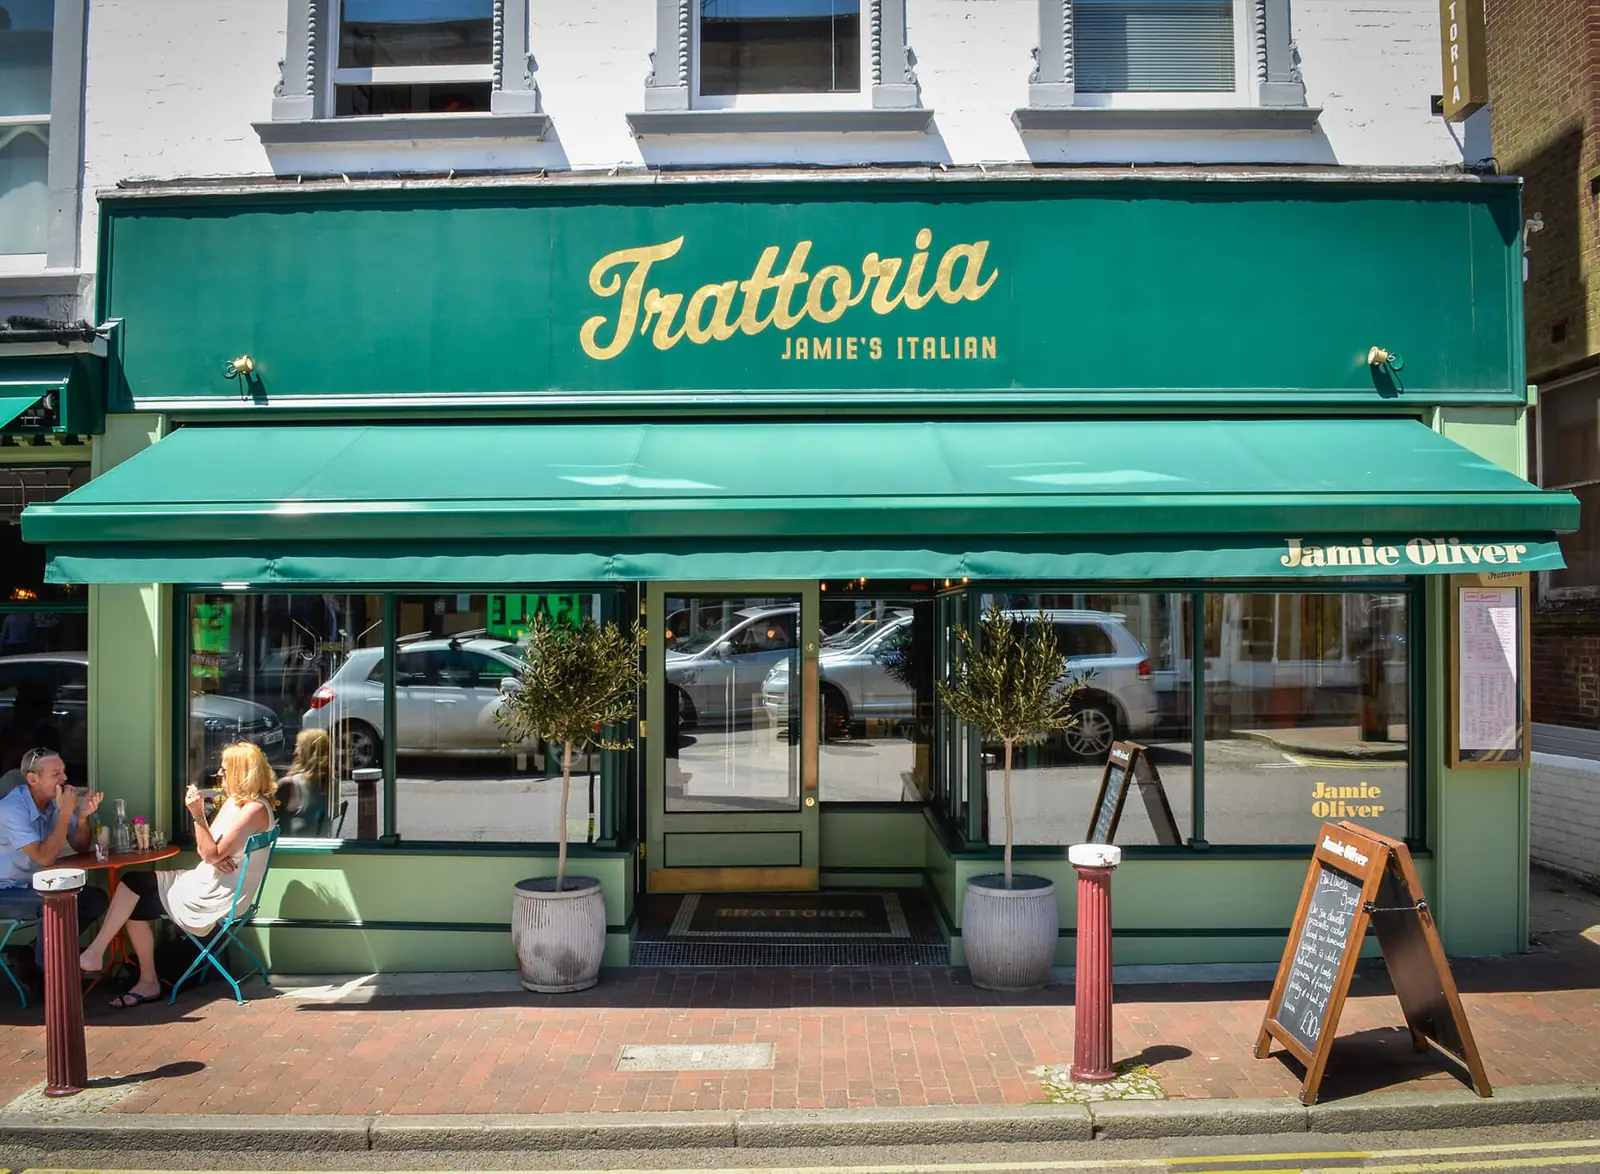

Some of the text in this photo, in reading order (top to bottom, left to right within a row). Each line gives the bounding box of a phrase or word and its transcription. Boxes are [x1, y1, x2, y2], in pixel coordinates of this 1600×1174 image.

[580, 228, 998, 360] Trattoria
[781, 336, 997, 359] JAMIE'S ITALIAN
[1280, 537, 1527, 567] Jamie Oliver
[1312, 782, 1381, 799] Jamie
[1312, 800, 1384, 818] Oliver
[717, 908, 865, 918] TRATTORIA
